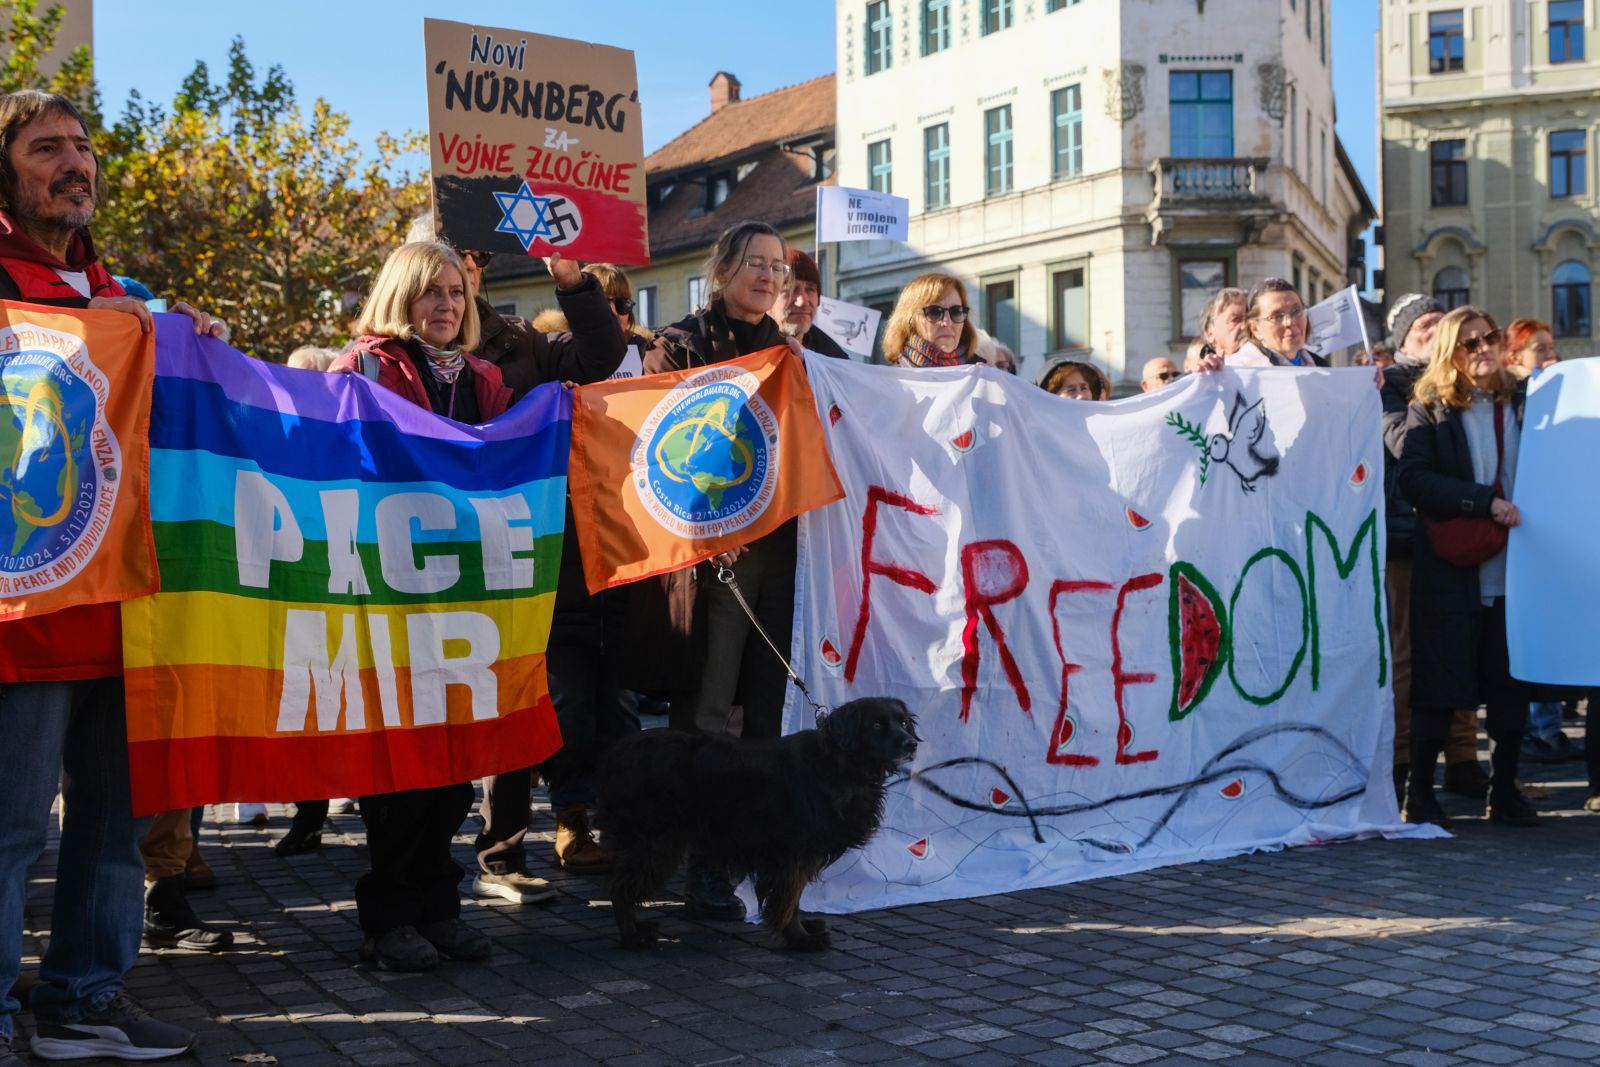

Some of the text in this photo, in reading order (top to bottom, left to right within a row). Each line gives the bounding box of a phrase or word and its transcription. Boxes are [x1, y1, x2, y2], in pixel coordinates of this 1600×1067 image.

[470, 33, 528, 71] Novi
[543, 128, 580, 151] ZA
[848, 198, 862, 209] NE
[84, 368, 115, 467] NONVENZA
[13, 568, 55, 592] PEACE
[51, 556, 77, 579] AND
[72, 485, 115, 564] NONVIOLENCE
[59, 481, 94, 546] 5/1/2025
[234, 470, 535, 595] PACE
[652, 479, 673, 508] Costa
[673, 503, 693, 520] Rica
[696, 496, 748, 520] 2/10/2024
[843, 484, 1388, 766] FREEDOM
[276, 609, 501, 732] MIR
